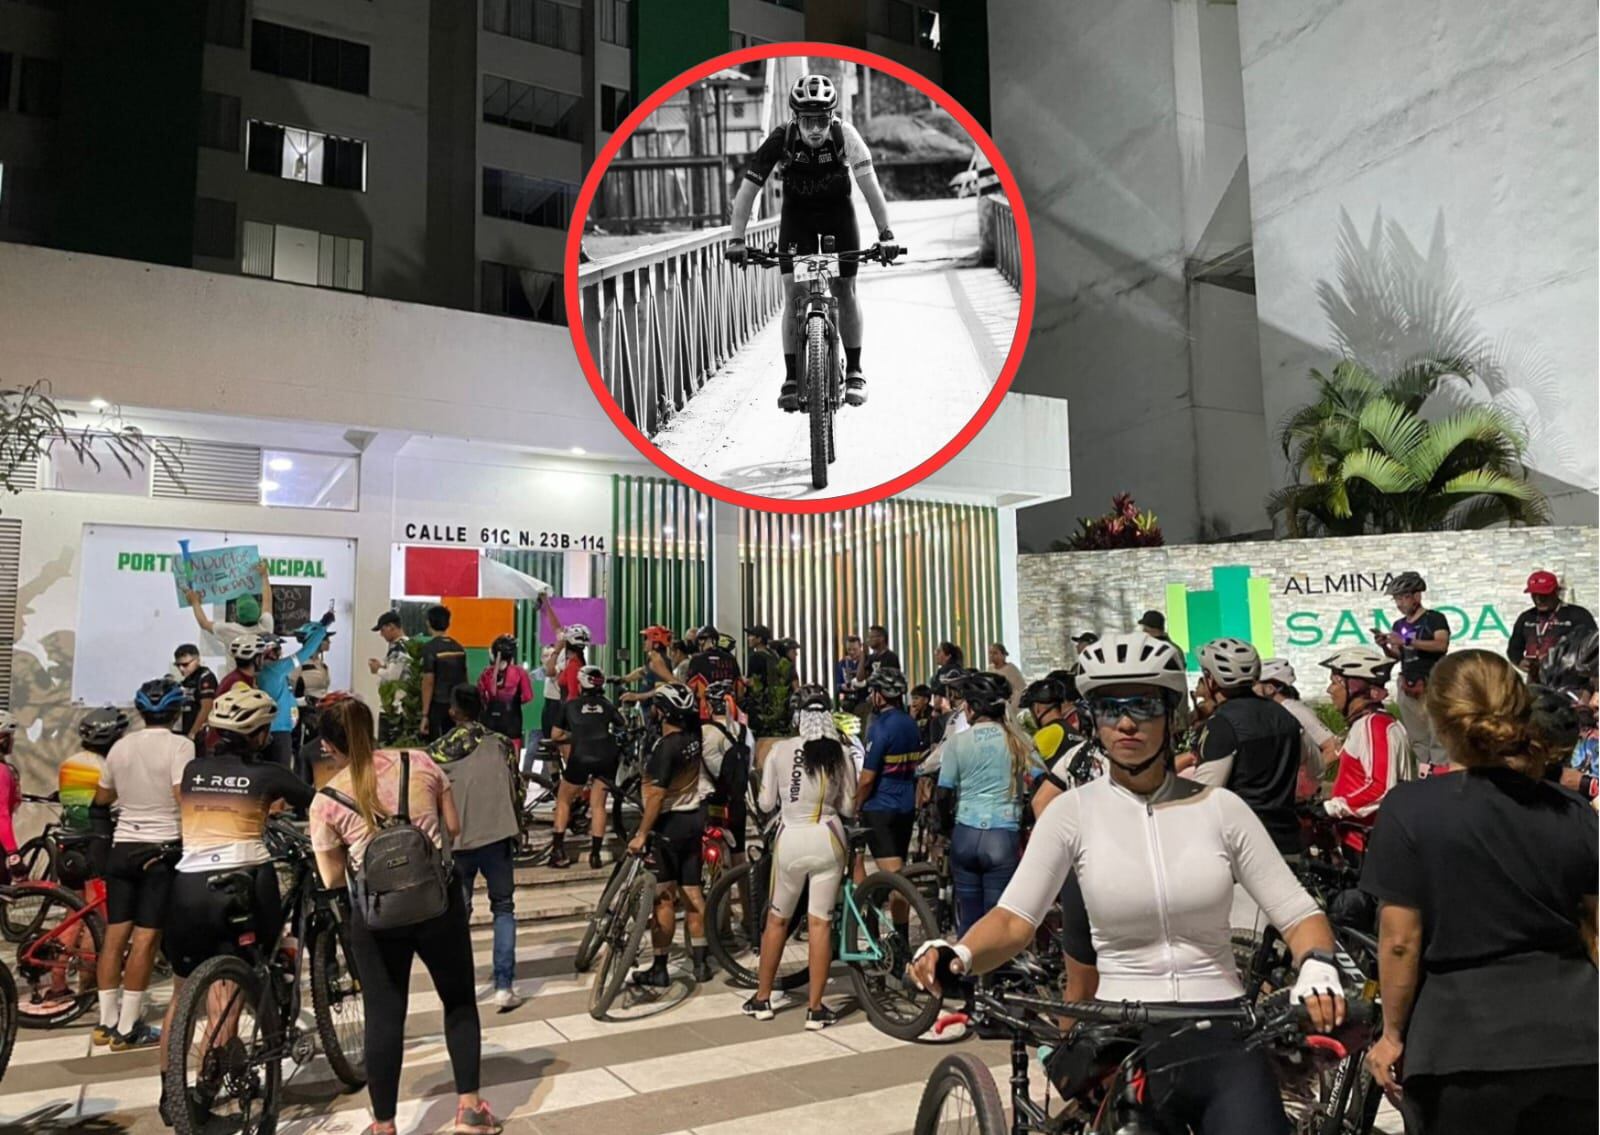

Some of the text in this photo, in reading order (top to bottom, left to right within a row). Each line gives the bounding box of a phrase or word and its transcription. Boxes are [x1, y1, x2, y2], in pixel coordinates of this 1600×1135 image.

[807, 260, 828, 272] 22
[405, 523, 467, 542] CALLE
[480, 528, 510, 544] 61C
[519, 531, 535, 546] N.
[118, 552, 325, 577] PORT NCIPAL
[1284, 572, 1396, 595] ALMINA
[211, 775, 250, 788] RED
[790, 749, 804, 803] COLOMBIA
